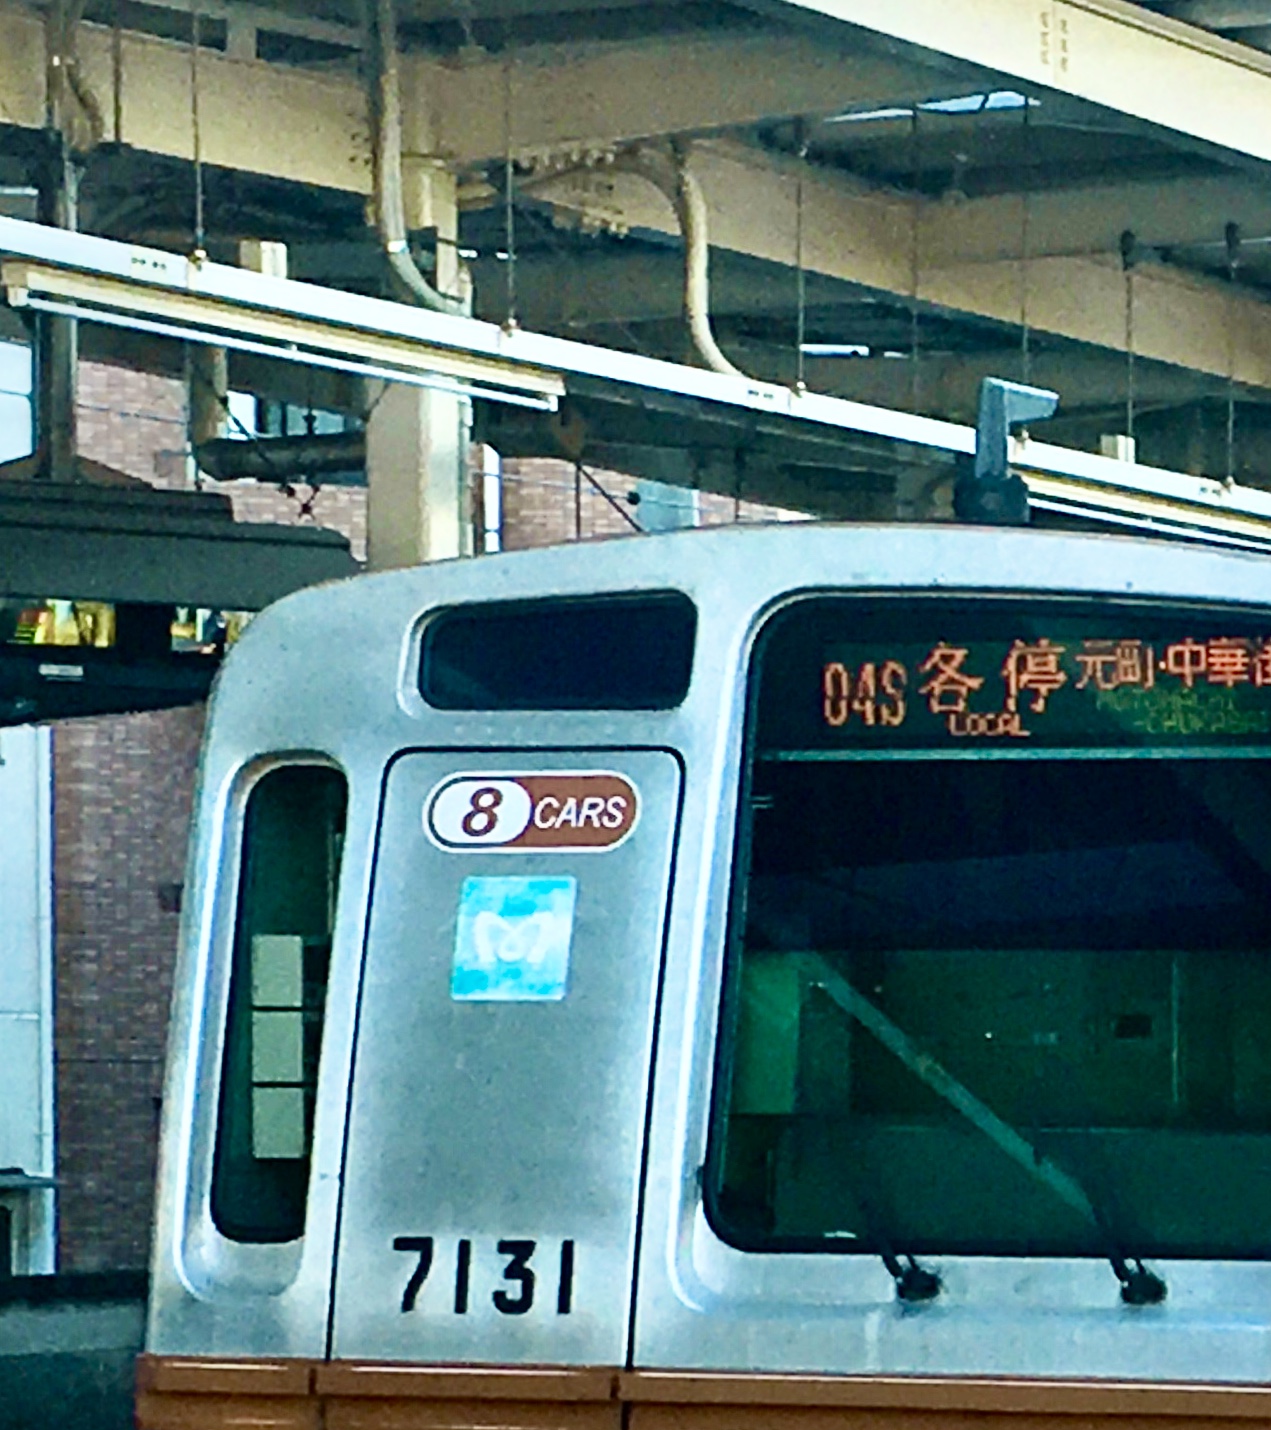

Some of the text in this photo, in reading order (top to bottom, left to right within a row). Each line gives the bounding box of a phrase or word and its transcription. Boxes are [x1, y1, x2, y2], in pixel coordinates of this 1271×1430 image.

[824, 660, 907, 727] 04S
[949, 712, 1031, 737] LOCAL
[460, 786, 628, 838] 8 CARS
[392, 1235, 576, 1315] 7131
